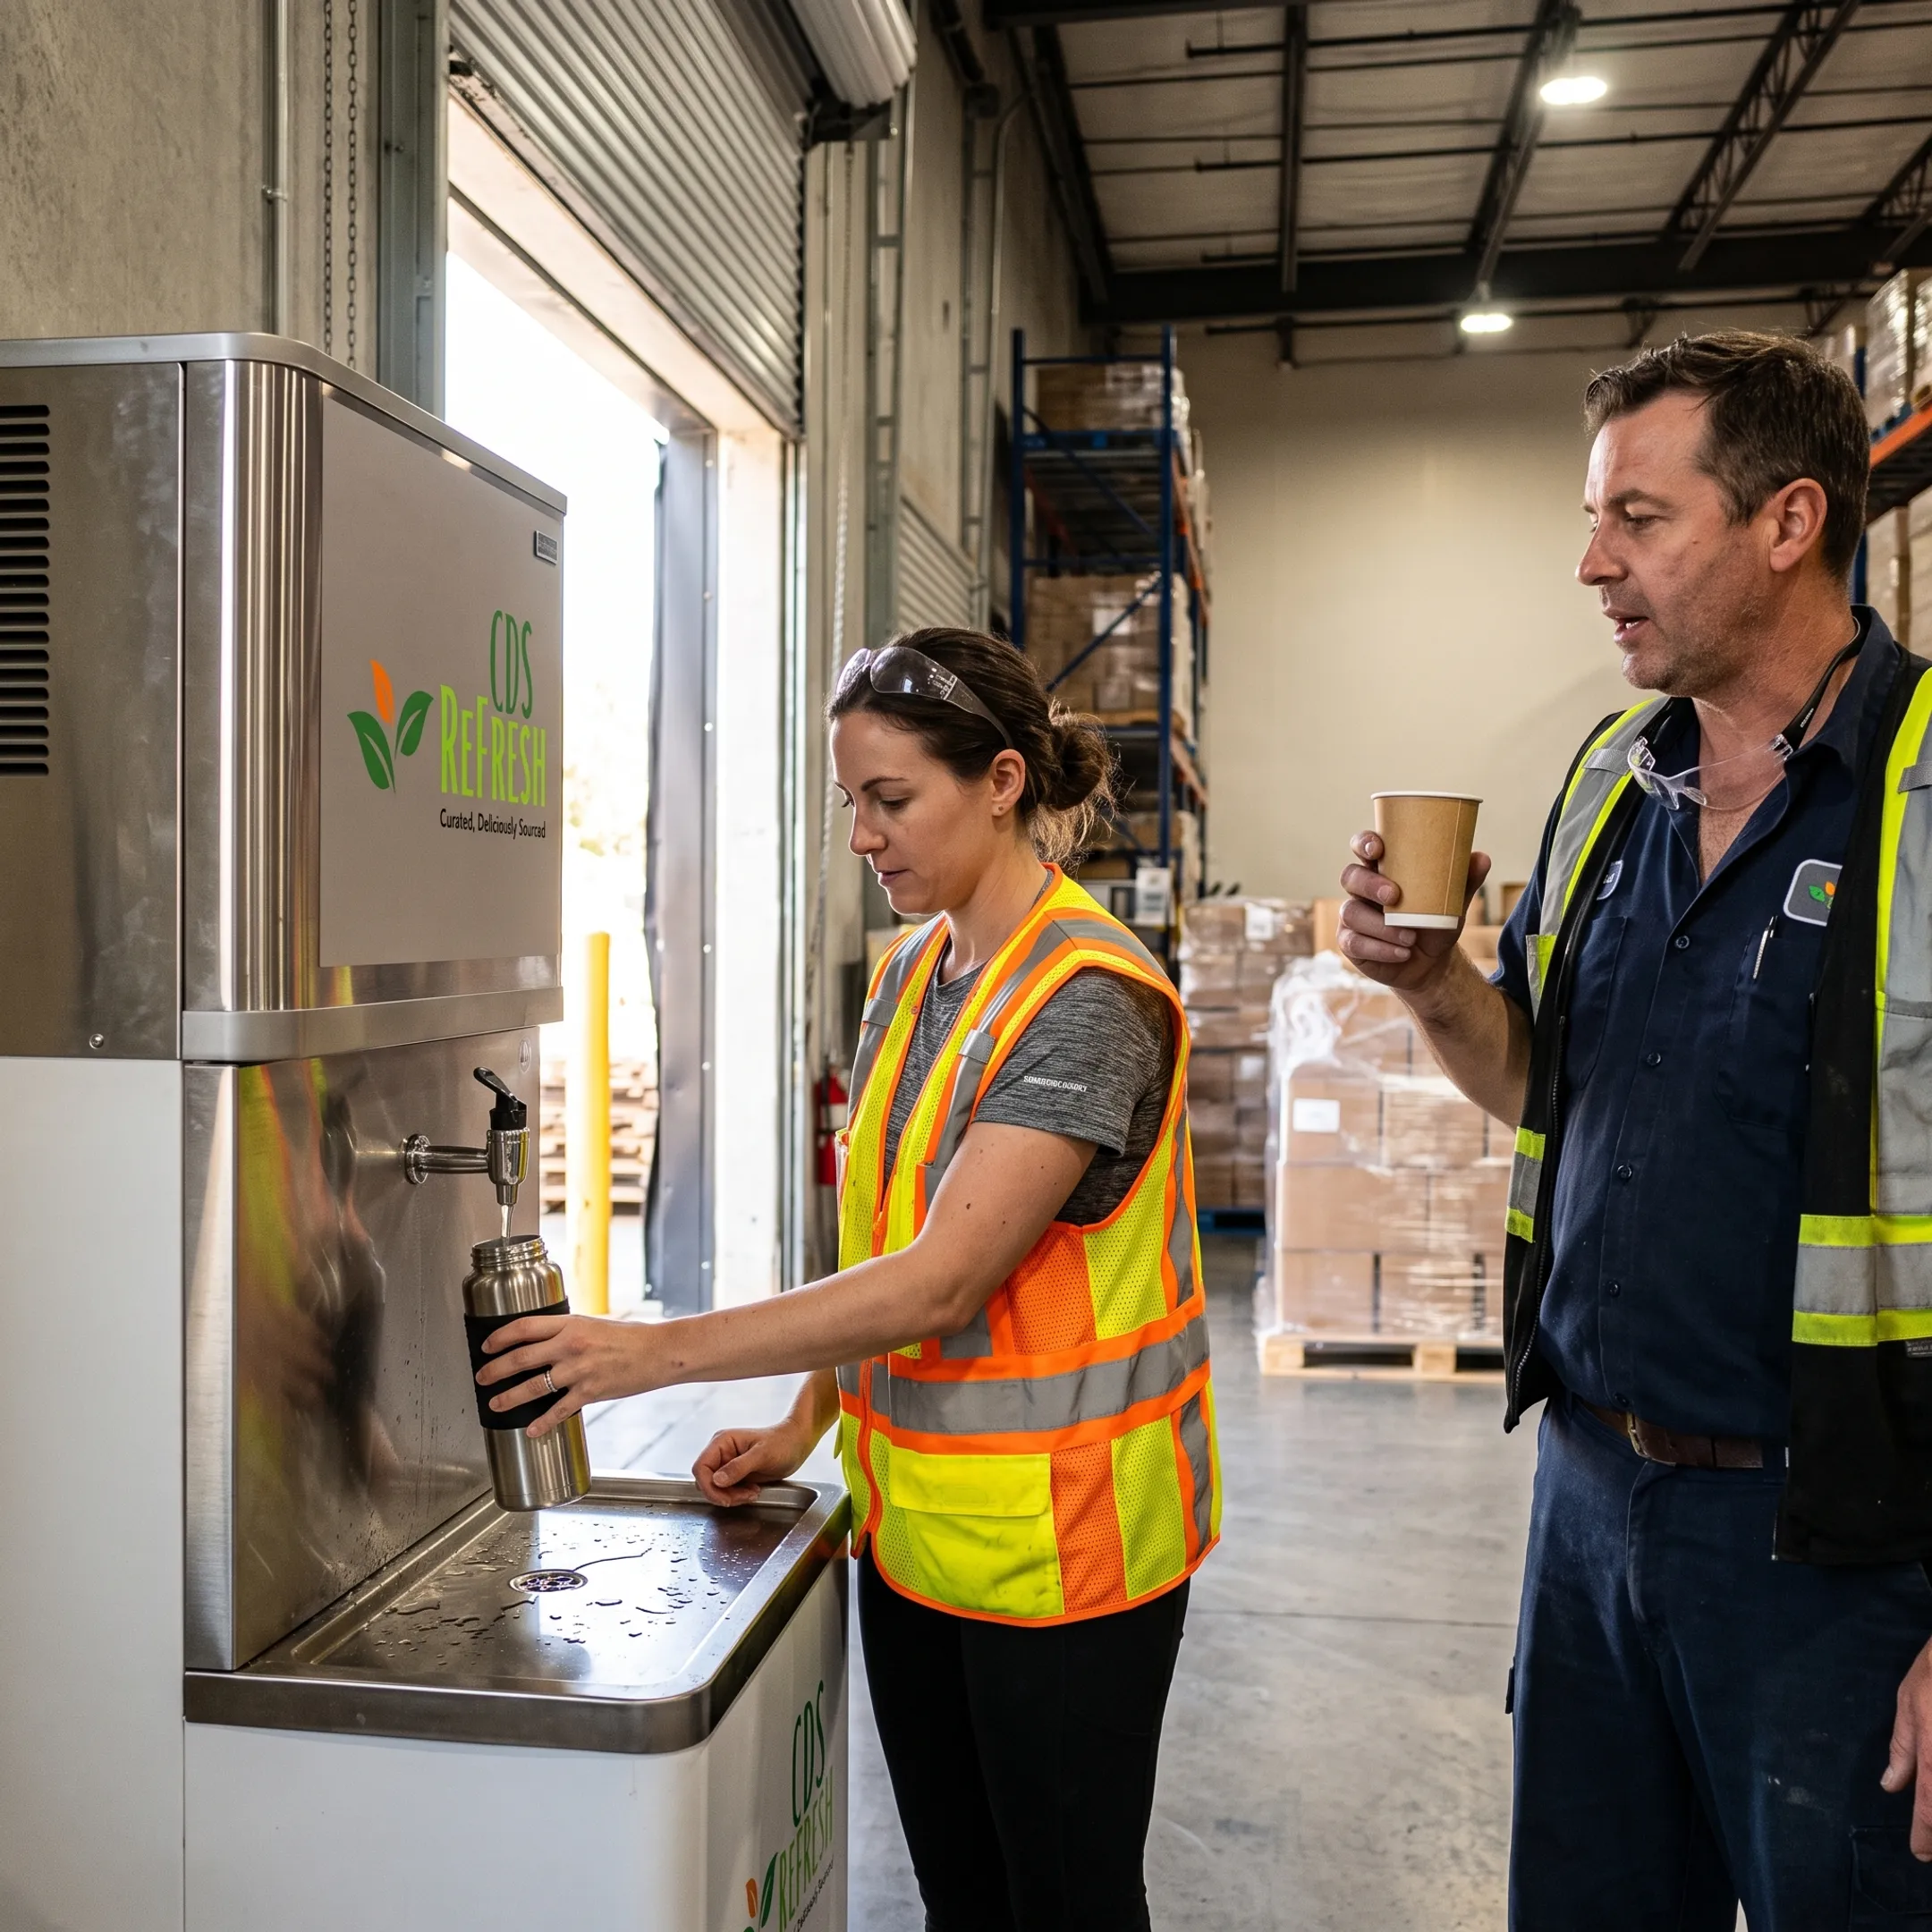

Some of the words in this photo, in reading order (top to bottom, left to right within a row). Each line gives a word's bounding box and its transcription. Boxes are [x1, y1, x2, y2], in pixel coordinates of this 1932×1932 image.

[490, 610, 532, 718] CDS
[440, 808, 475, 833] Curated,
[478, 812, 517, 840] Deliciously
[792, 1680, 825, 1827] CDS
